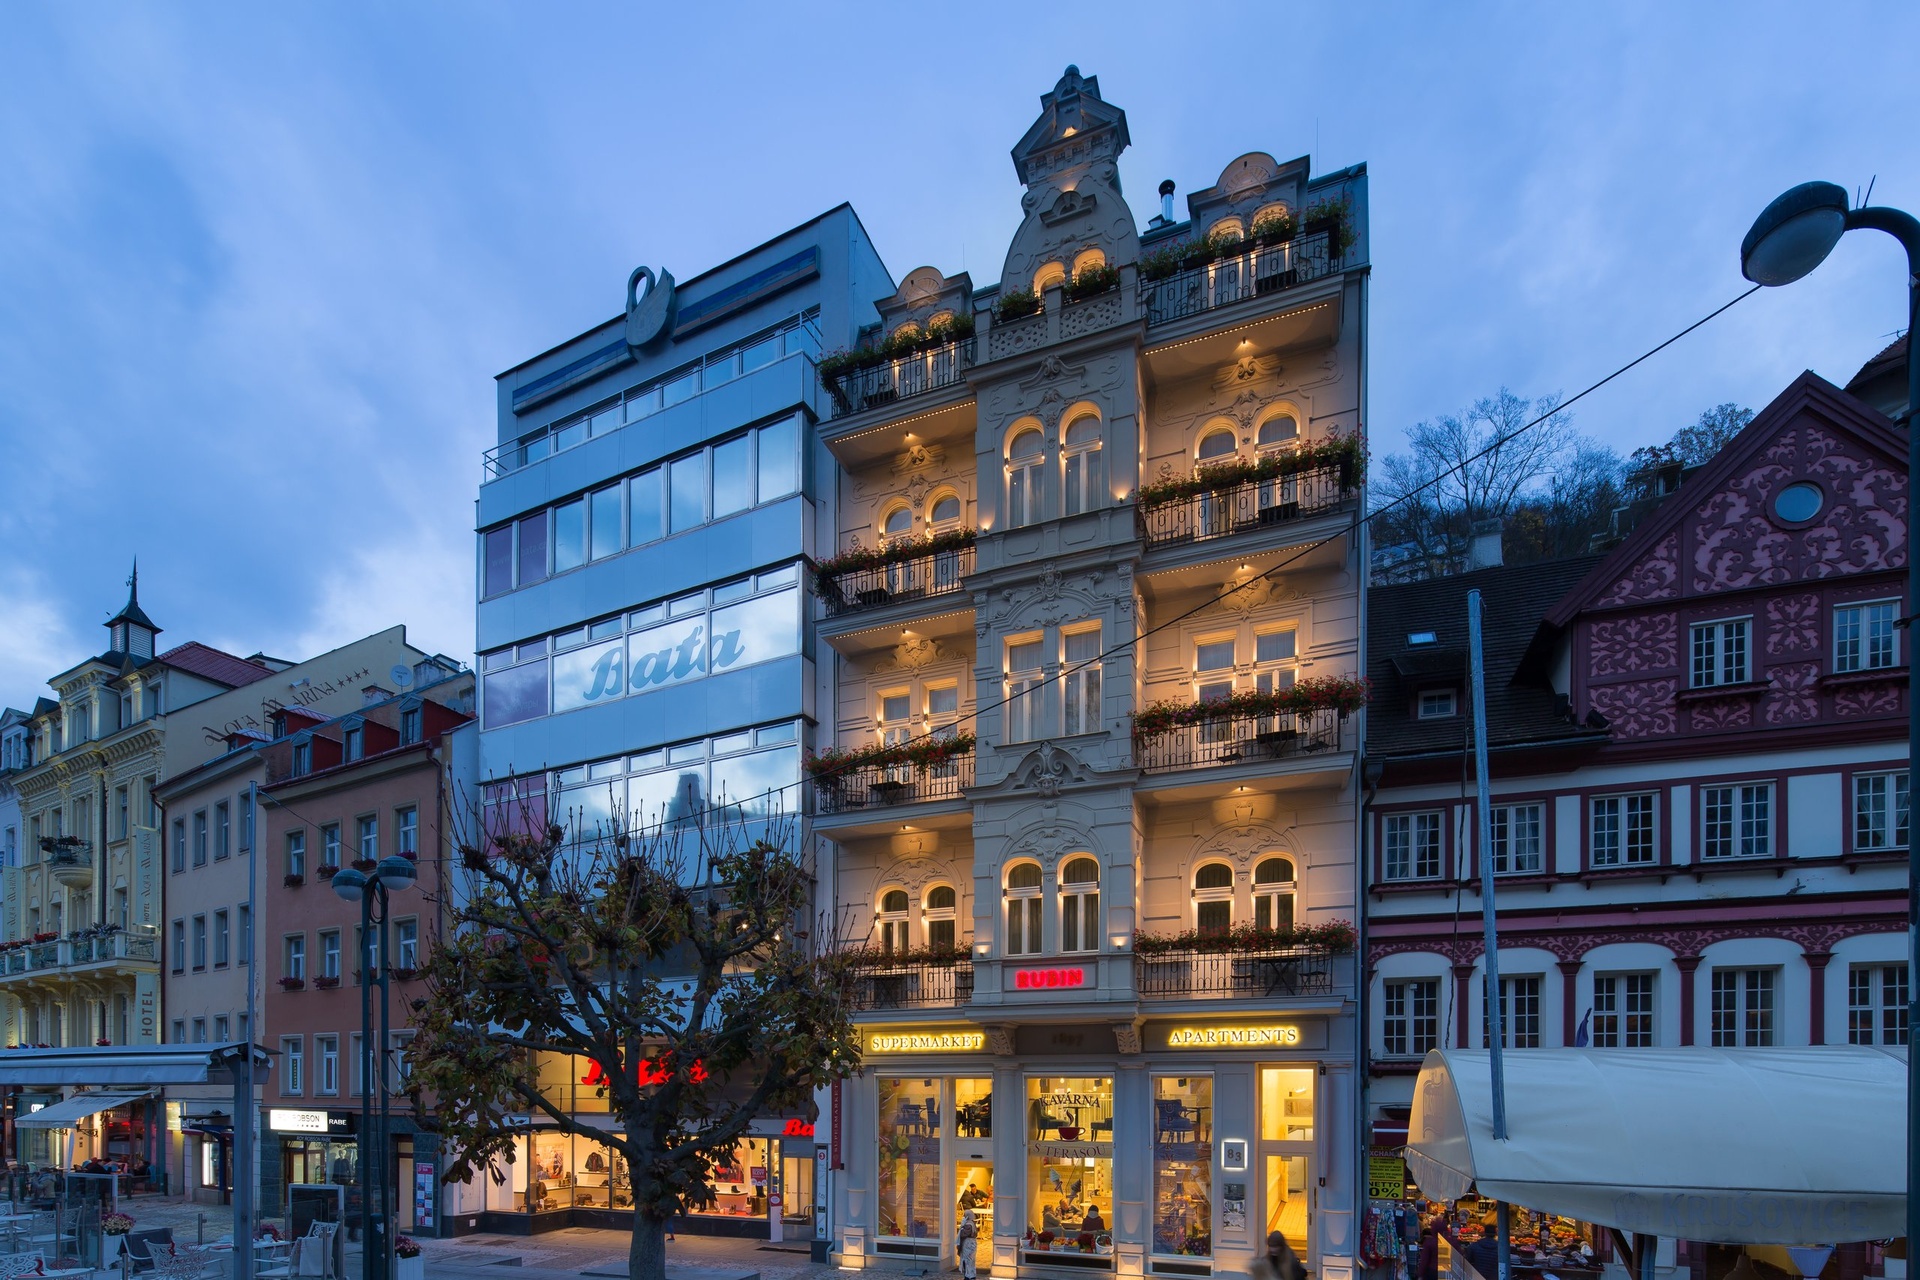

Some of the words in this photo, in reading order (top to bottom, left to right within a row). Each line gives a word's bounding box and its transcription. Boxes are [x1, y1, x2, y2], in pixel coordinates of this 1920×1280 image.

[583, 625, 746, 700] Baťa
[1016, 969, 1083, 988] RUBIN
[141, 991, 153, 1037] HOTEL
[872, 1036, 983, 1049] SUPERMARKET
[1171, 1029, 1297, 1043] APARTMENTS
[1039, 1092, 1101, 1108] KAVÁRNA
[292, 1114, 320, 1123] OBSON
[328, 1118, 347, 1126] RABE
[1033, 1144, 1040, 1152] S
[1045, 1145, 1105, 1158] TERASOU
[1227, 1149, 1241, 1162] 83
[1662, 1190, 1869, 1231] KRUŠOVICE
